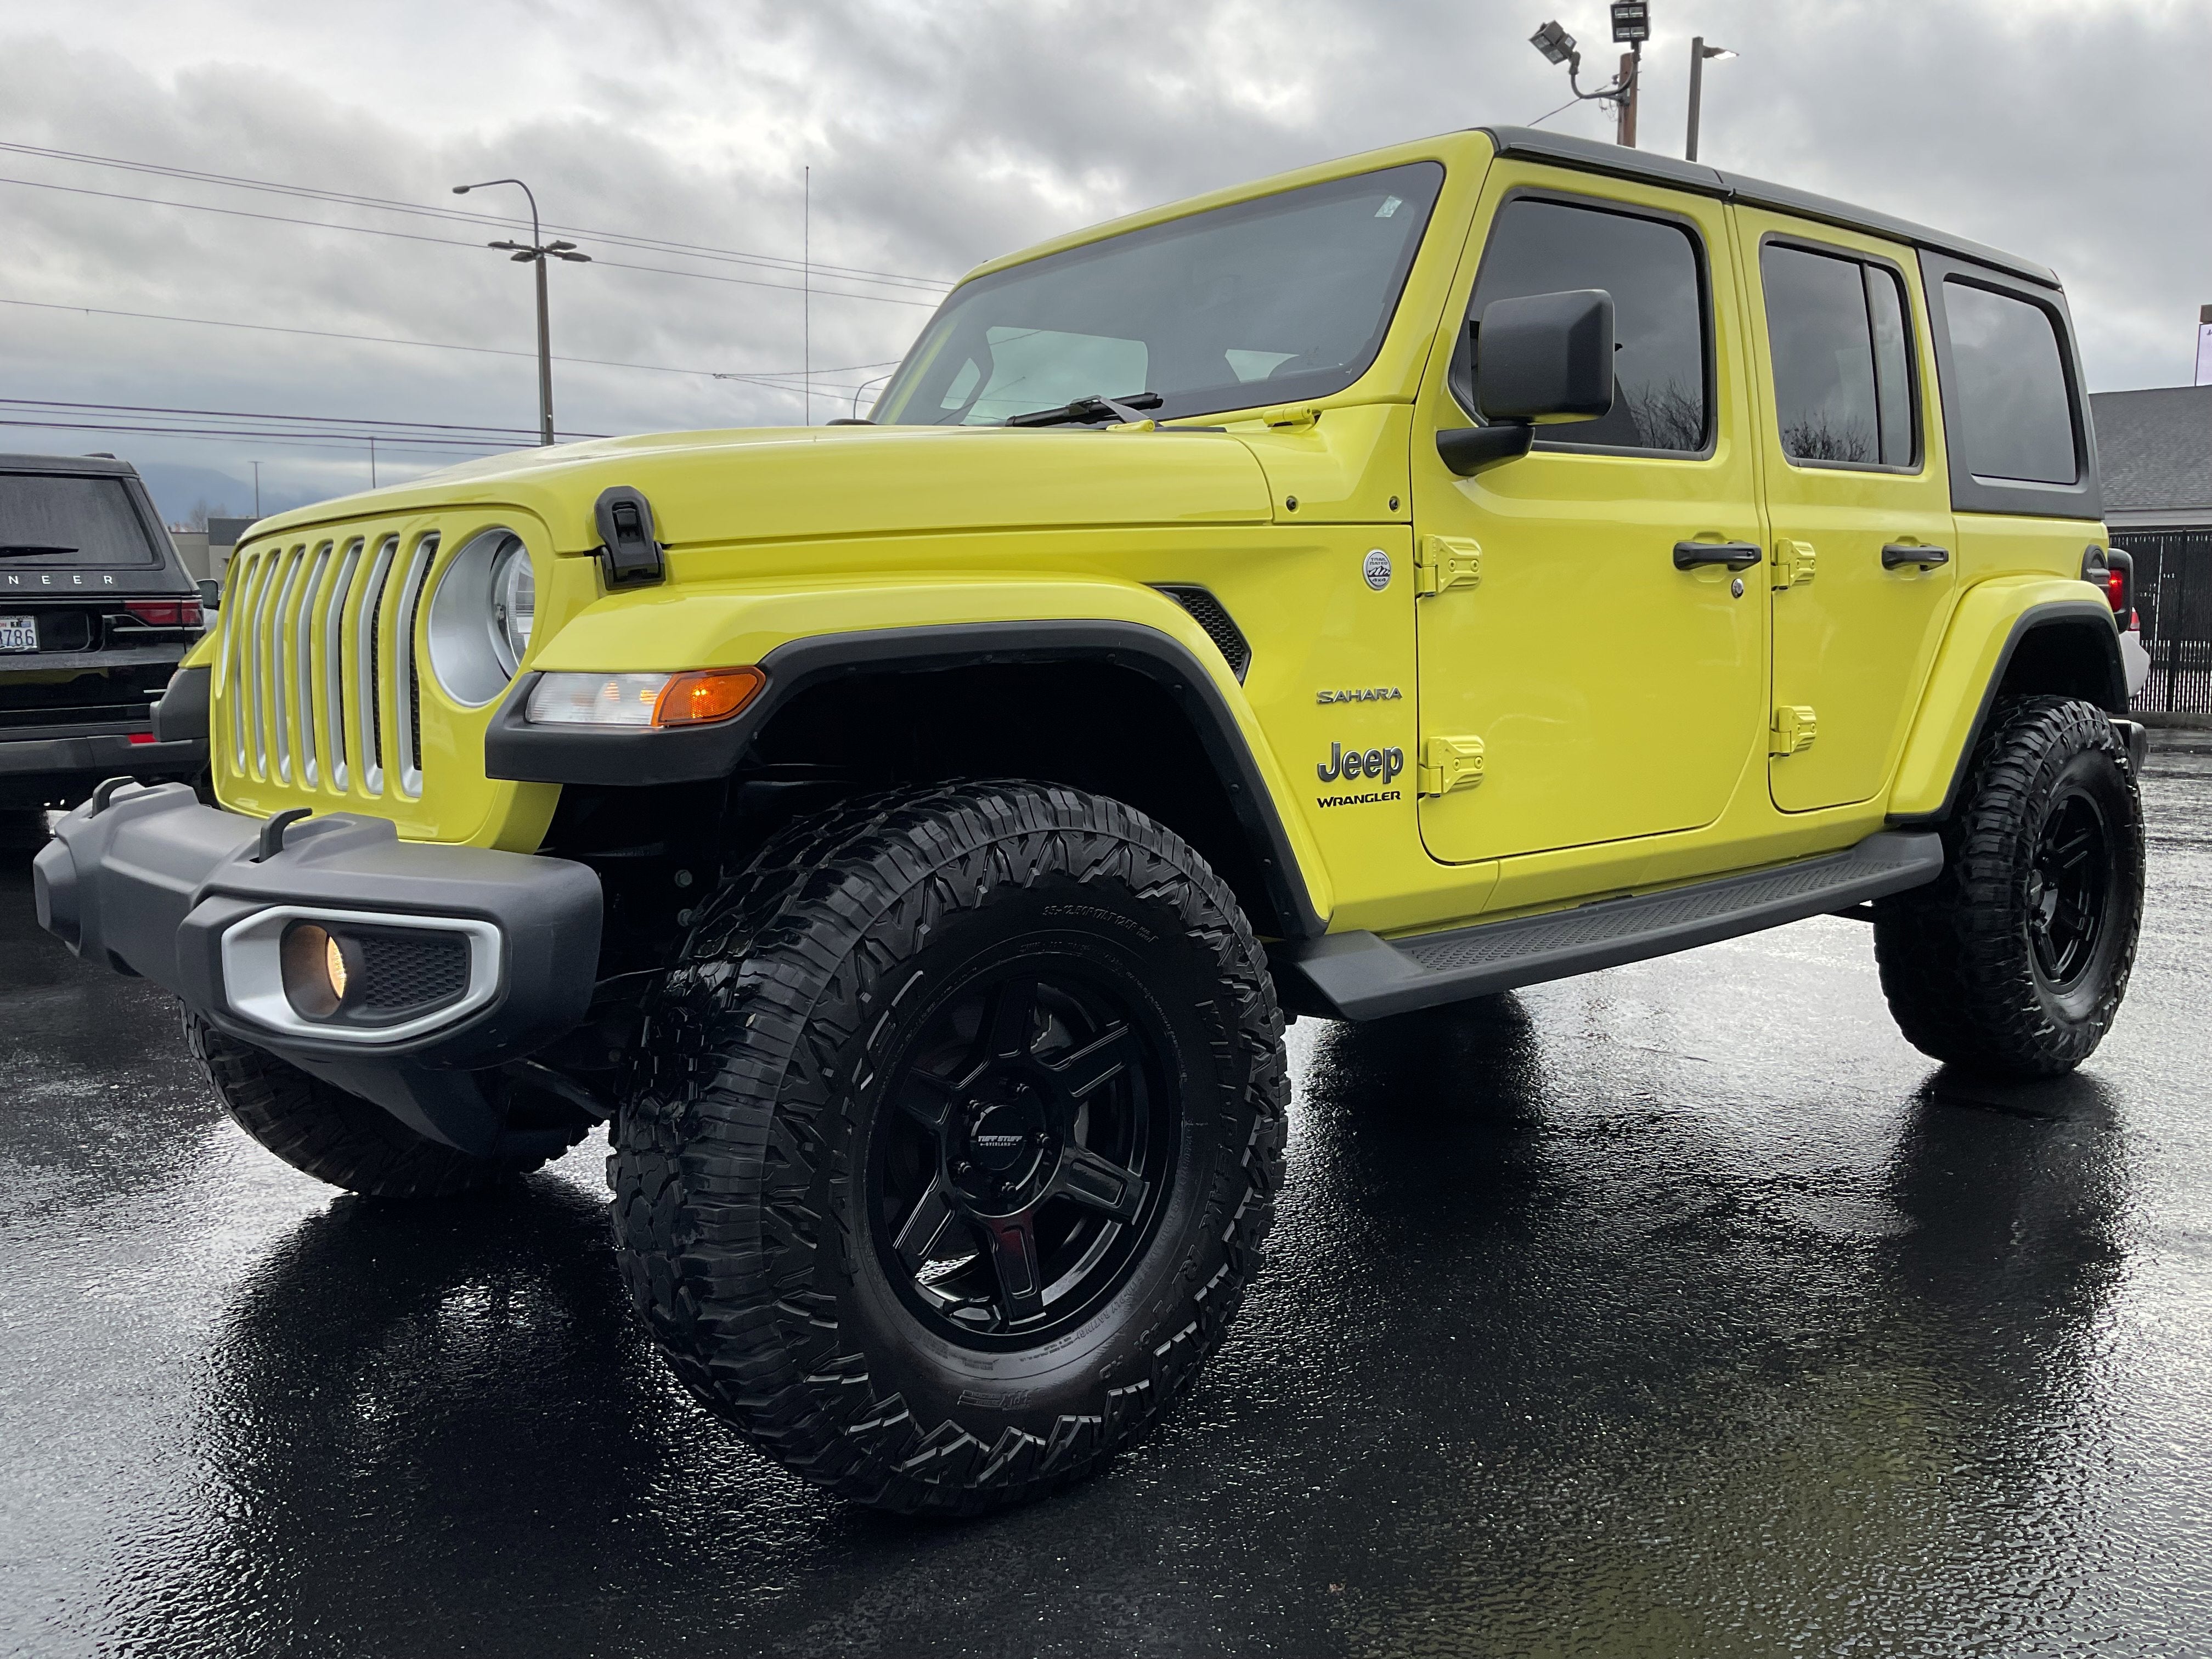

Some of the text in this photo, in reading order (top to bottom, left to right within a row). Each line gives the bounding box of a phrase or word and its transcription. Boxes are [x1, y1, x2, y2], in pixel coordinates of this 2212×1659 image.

[1317, 687, 1403, 703] SAHARA
[1317, 742, 1403, 784] Jeep
[1317, 791, 1401, 808] WRANGLER
